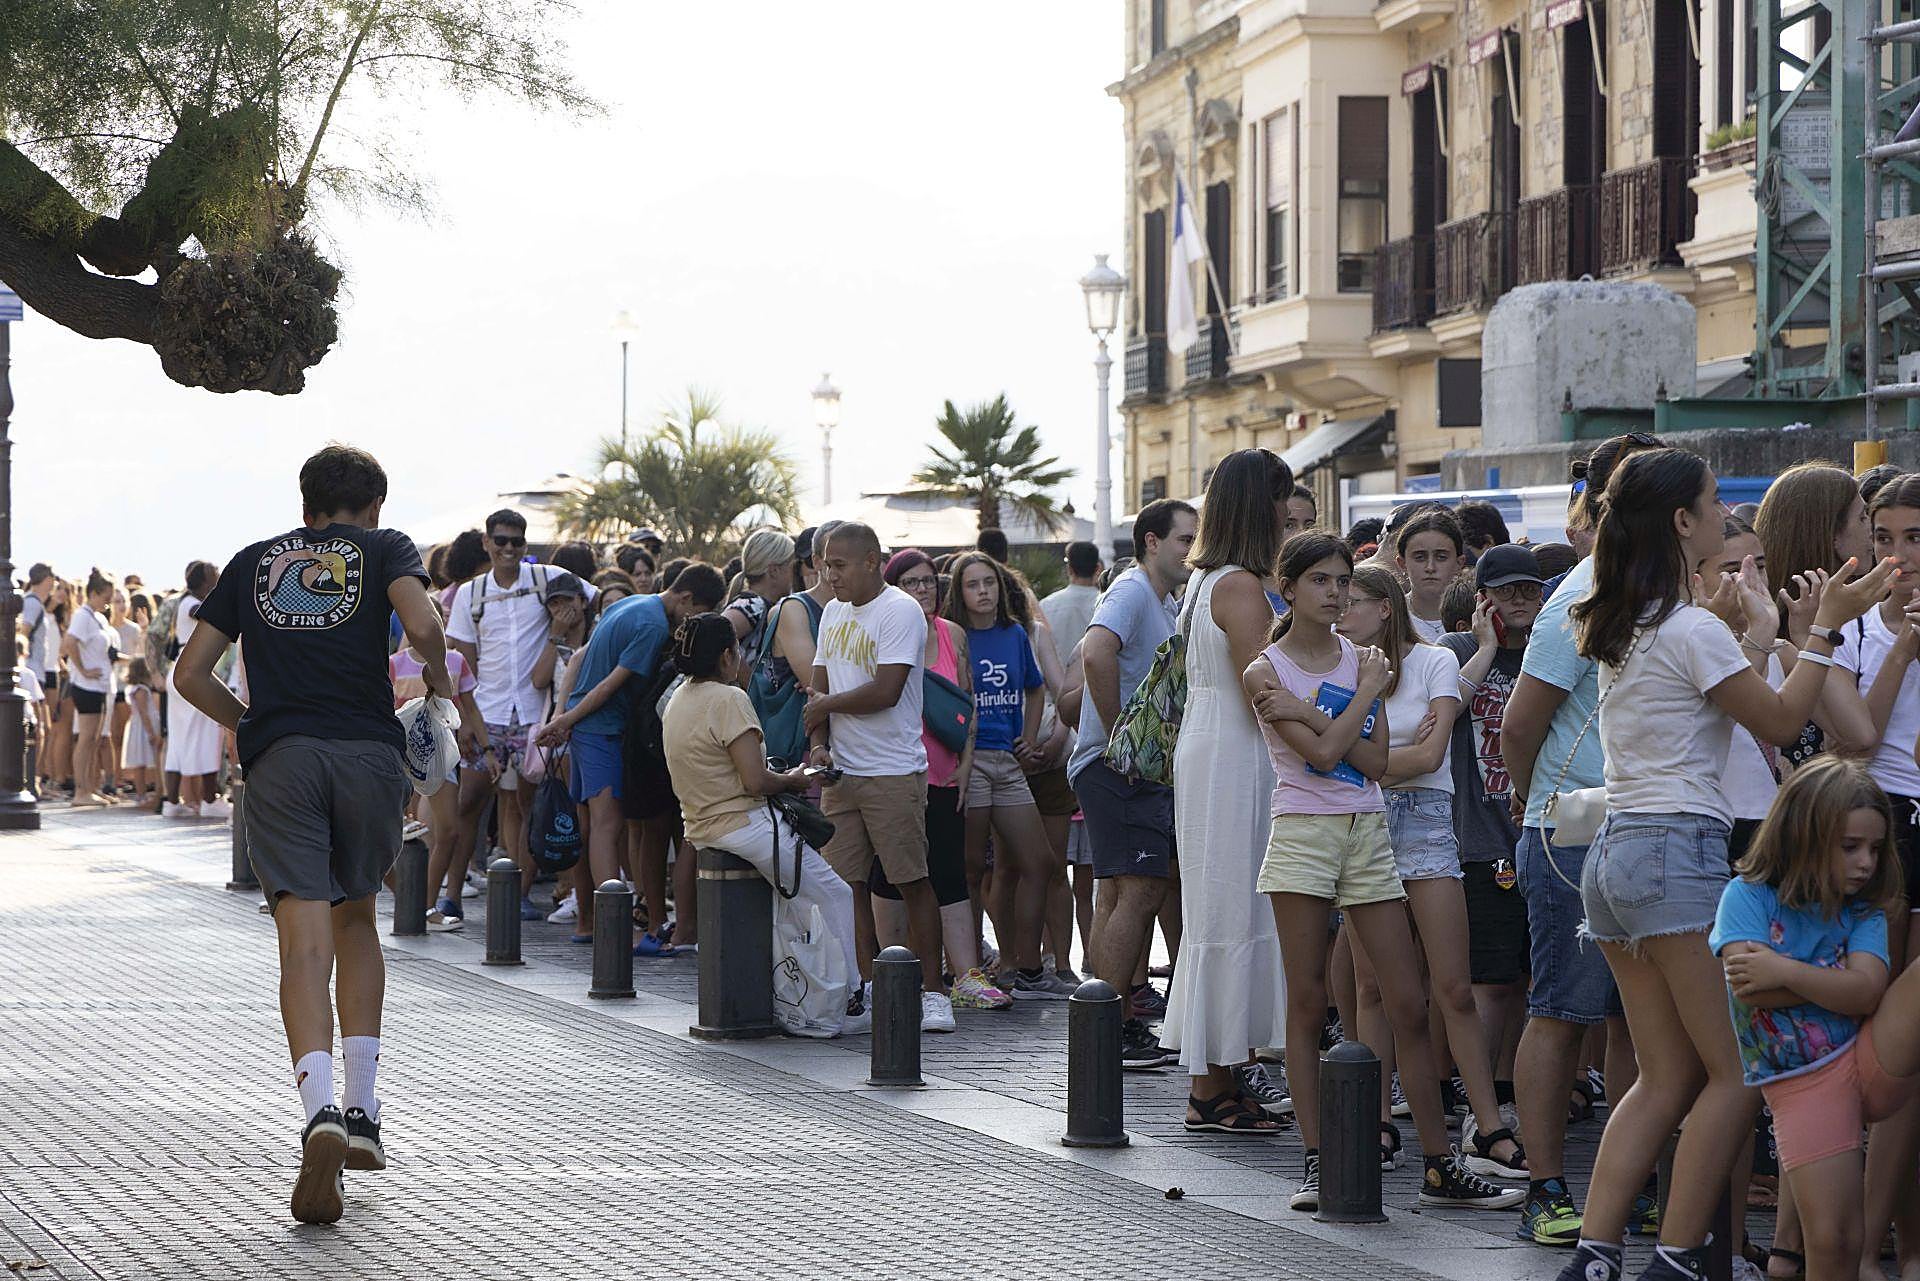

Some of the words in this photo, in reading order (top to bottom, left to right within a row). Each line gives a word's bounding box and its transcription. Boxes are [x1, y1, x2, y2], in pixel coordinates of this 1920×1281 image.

[258, 575, 268, 584] 19
[346, 570, 360, 578] 69
[258, 591, 287, 625] DOING
[291, 615, 325, 626] FINE
[329, 584, 358, 622] SINCE
[979, 659, 1008, 688] 25
